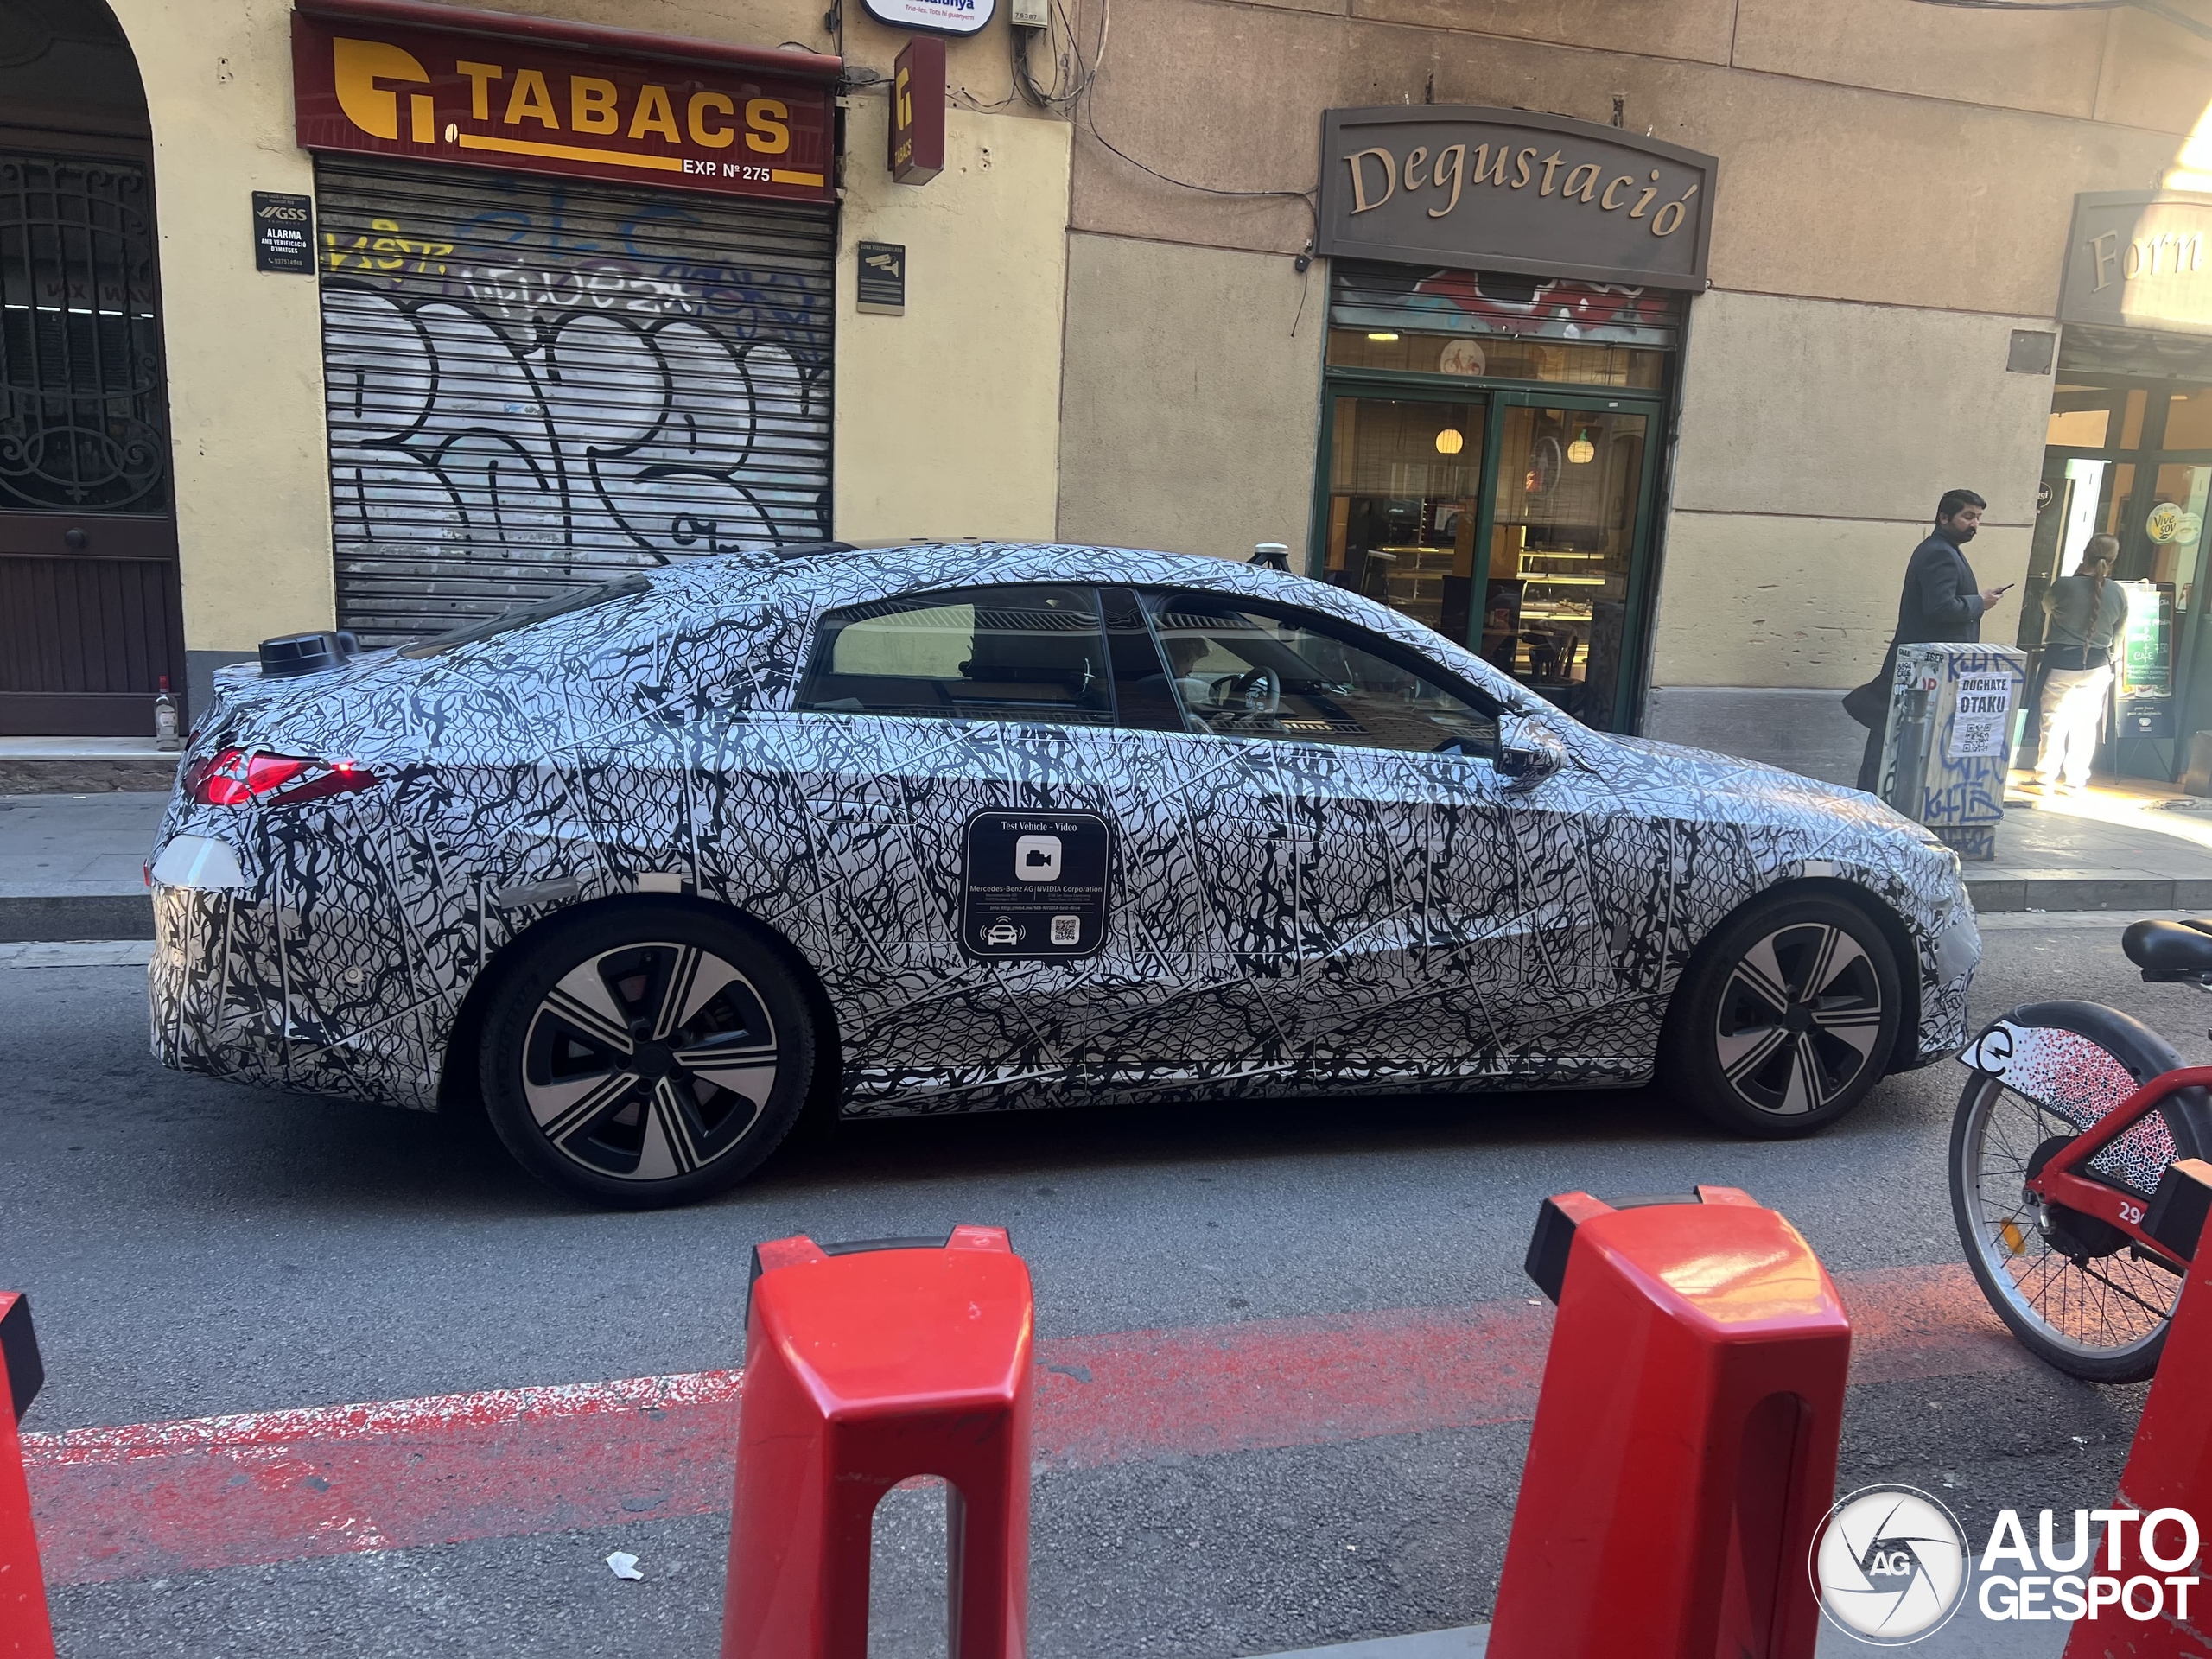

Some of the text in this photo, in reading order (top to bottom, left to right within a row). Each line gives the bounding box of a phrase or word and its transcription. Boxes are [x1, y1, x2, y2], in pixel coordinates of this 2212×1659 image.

[906, 4, 928, 14] Tria-les.
[929, 8, 941, 16] Tots
[948, 11, 975, 21] guanyem
[456, 60, 789, 154] TABACS
[683, 159, 771, 181] EXP. Nº 275
[1344, 143, 1697, 237] Degustació
[276, 207, 307, 221] GSS
[267, 228, 302, 240] ALARMA
[274, 239, 307, 248] VERIFICACIÓ
[2088, 229, 2203, 293] Forn
[2038, 491, 2049, 499] gi
[2153, 514, 2175, 527] Vive
[2159, 523, 2177, 535] soy
[1961, 696, 2006, 713] OTAKU
[1001, 821, 1018, 830] Test
[1019, 821, 1048, 831] Vehicle
[1055, 822, 1077, 832] Video
[1063, 885, 1103, 893] Corporation
[2119, 1201, 2146, 1224] 29
